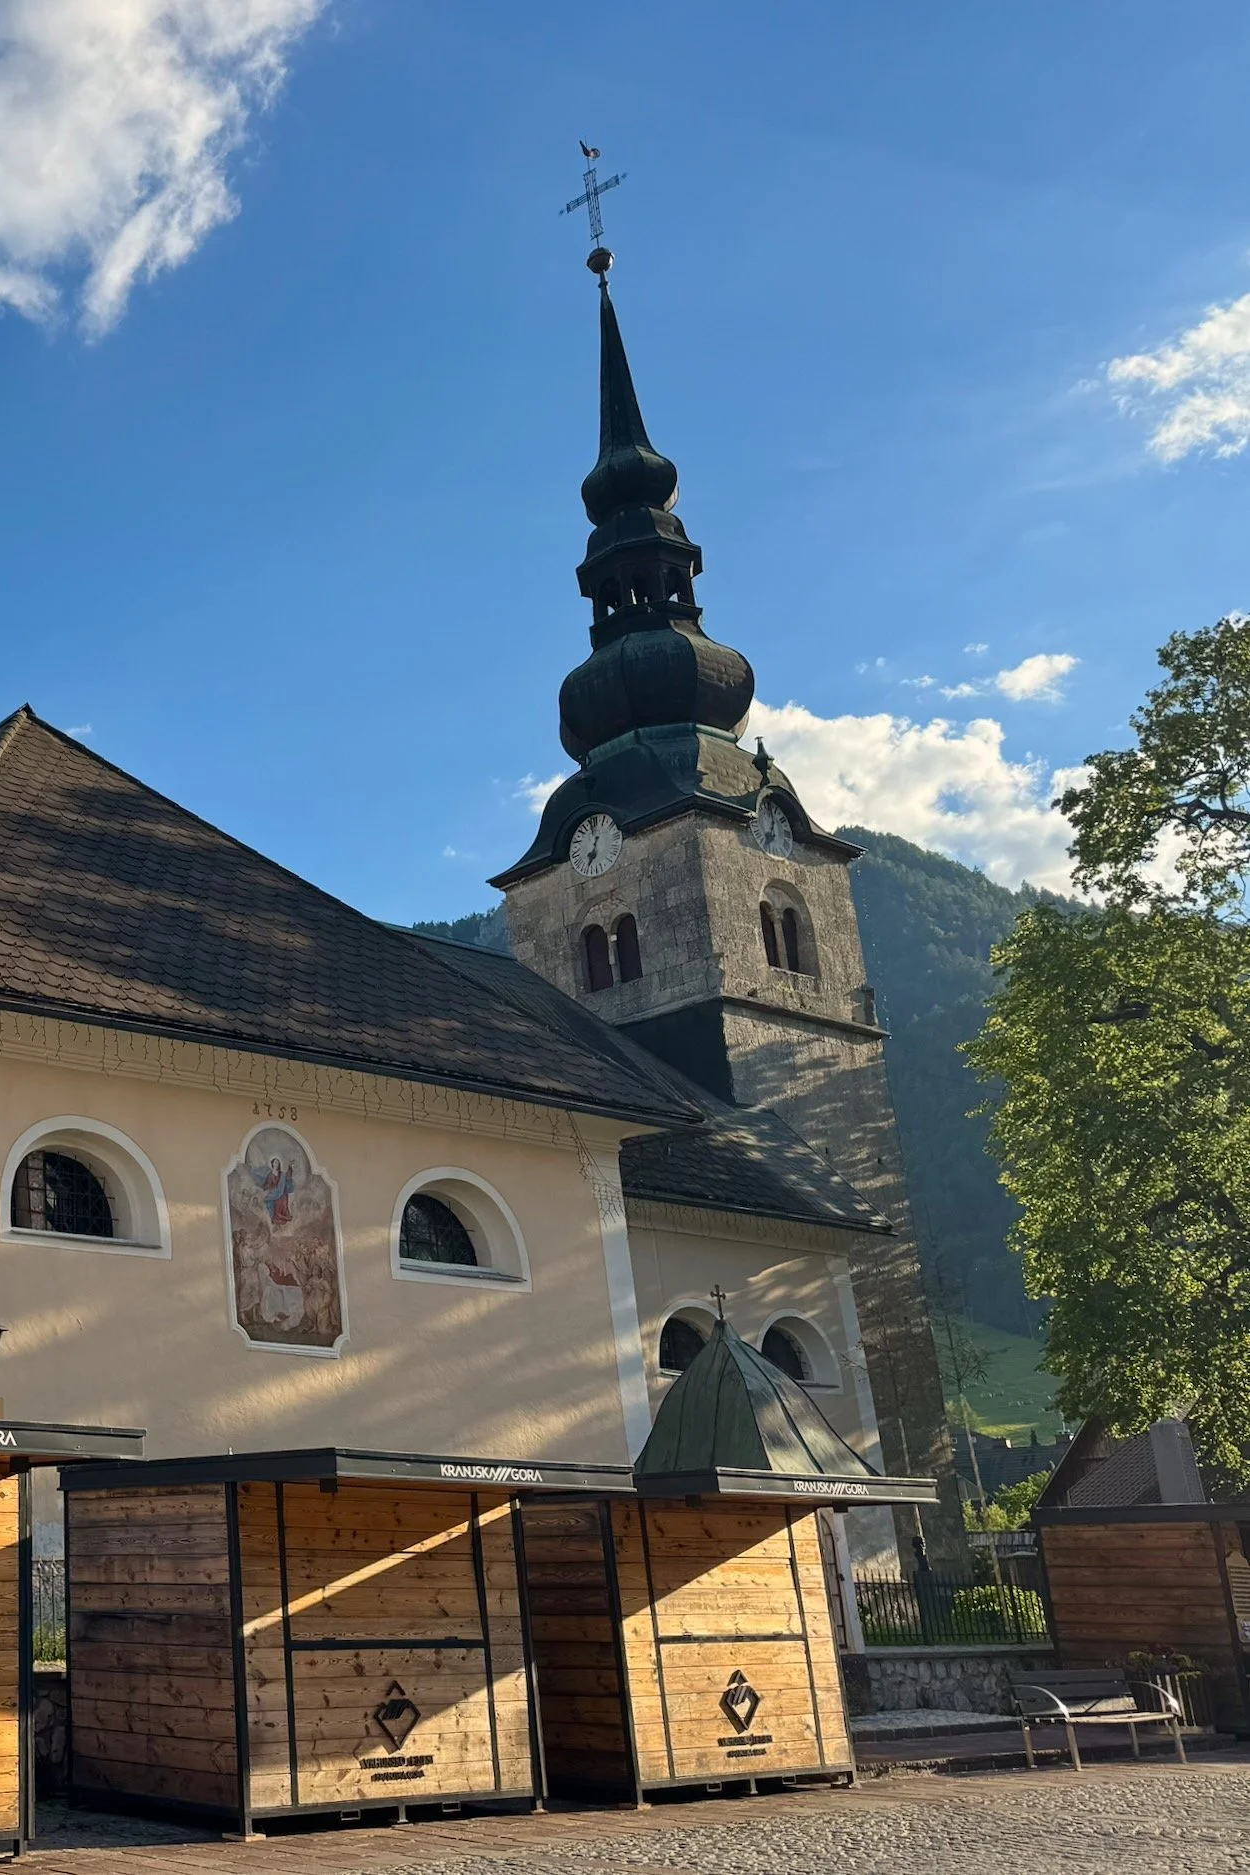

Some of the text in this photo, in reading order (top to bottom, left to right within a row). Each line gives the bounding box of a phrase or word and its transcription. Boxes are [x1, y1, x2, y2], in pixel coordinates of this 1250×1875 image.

[252, 1101, 298, 1122] 1758
[440, 1463, 543, 1482] KRANJSKA GORA
[793, 1479, 870, 1496] KRANJSKA GORA
